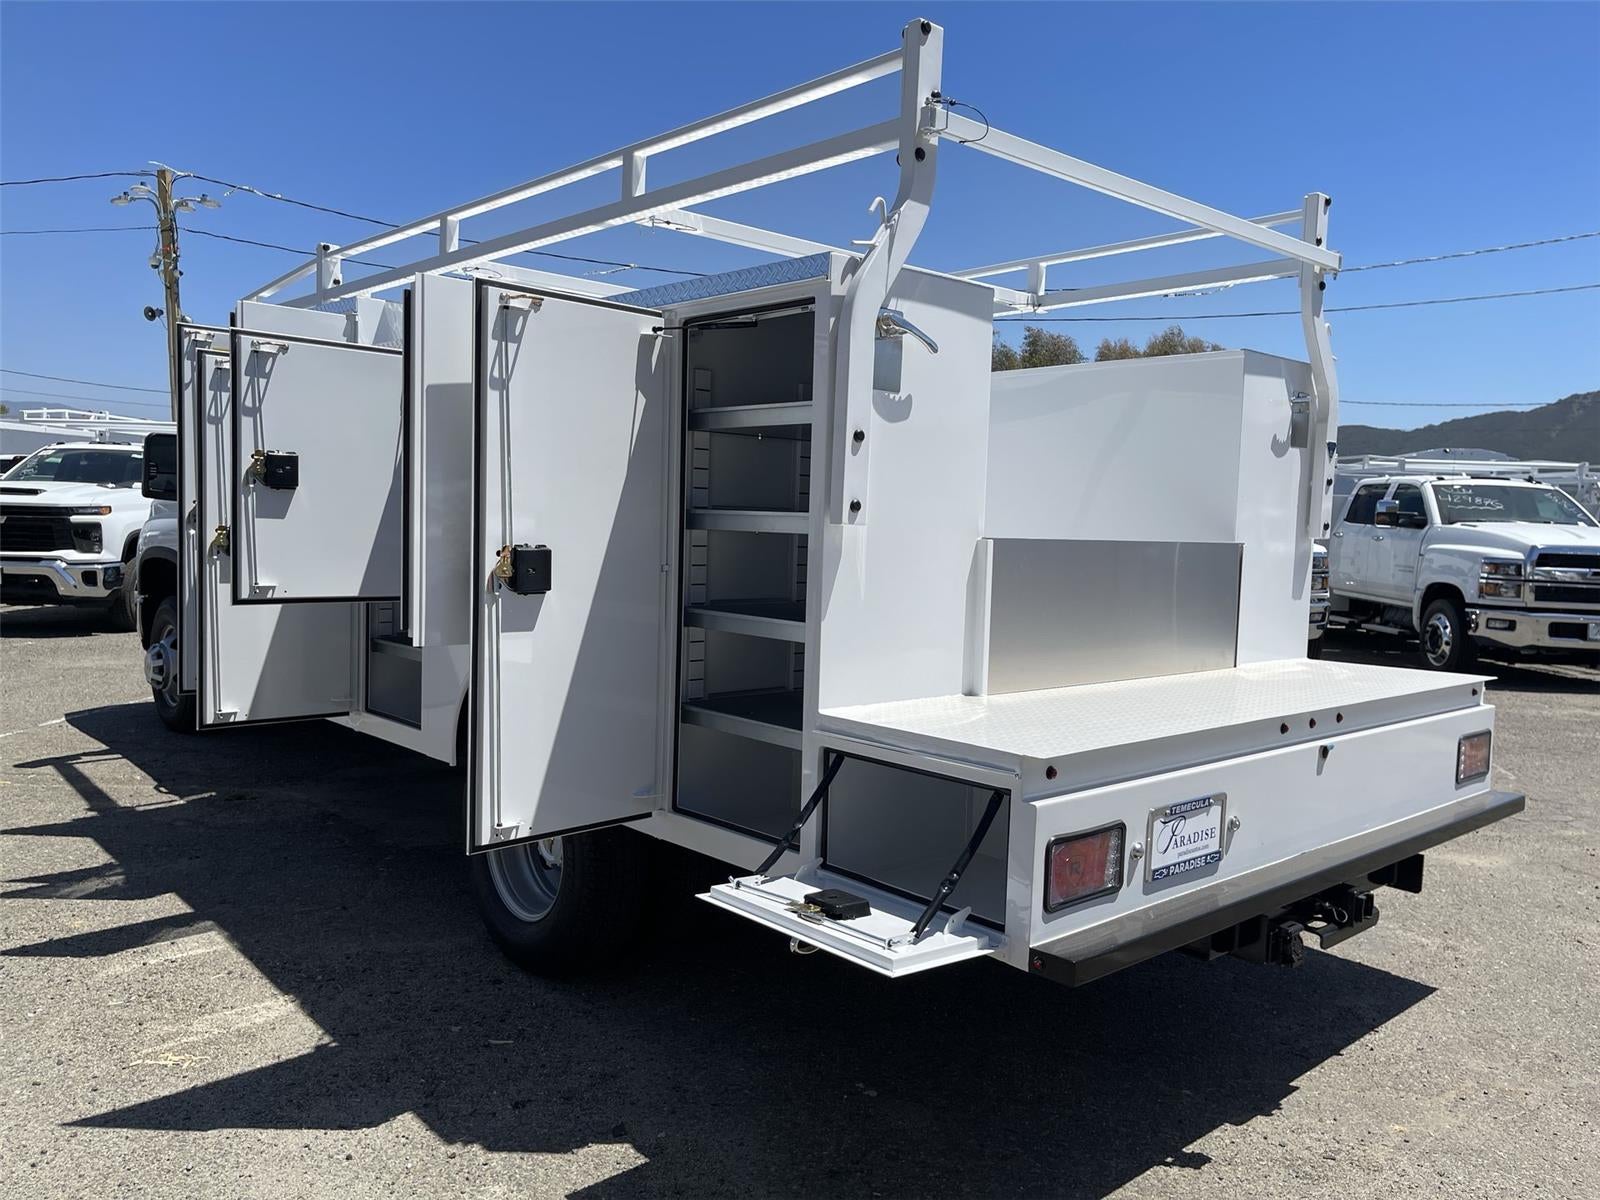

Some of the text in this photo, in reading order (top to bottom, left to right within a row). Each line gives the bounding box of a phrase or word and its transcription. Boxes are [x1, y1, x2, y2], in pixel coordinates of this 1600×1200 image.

[1171, 798, 1210, 815] TEMECULA
[1157, 815, 1216, 855] PARADISE
[1169, 857, 1206, 876] PARADISE
